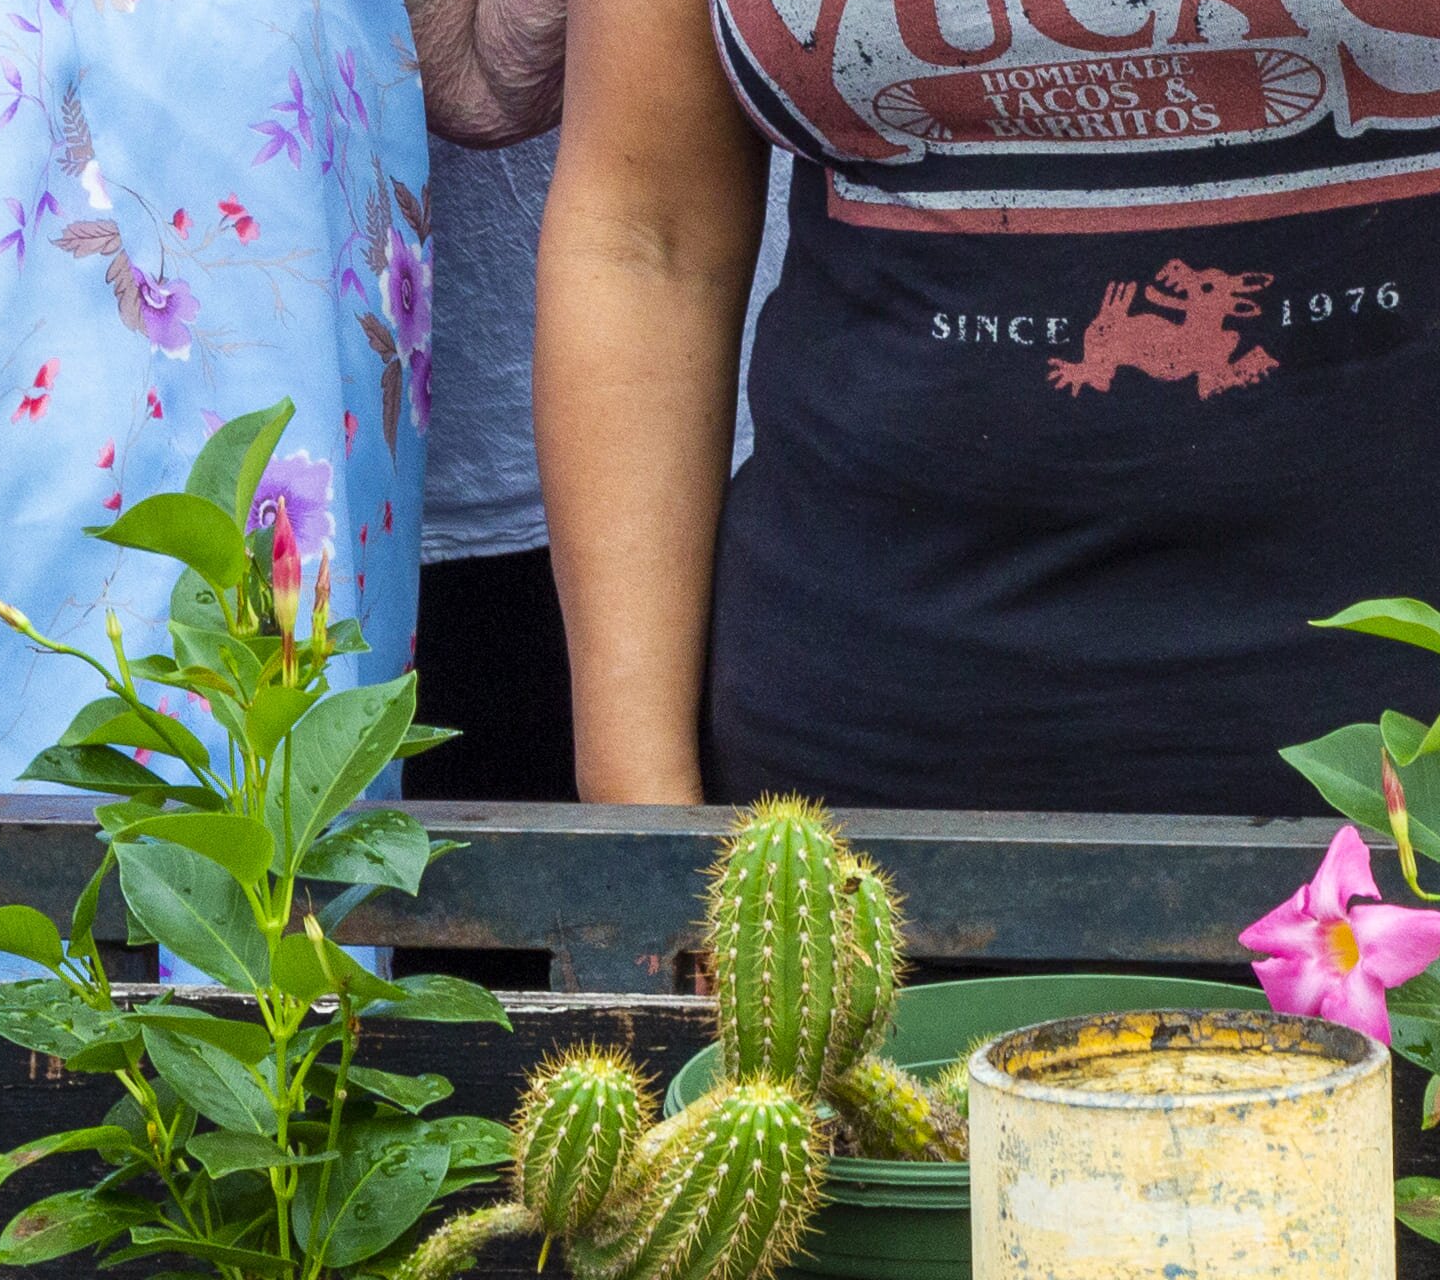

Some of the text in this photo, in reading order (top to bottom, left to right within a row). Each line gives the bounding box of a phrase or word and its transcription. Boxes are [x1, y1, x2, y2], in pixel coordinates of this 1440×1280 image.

[980, 54, 1194, 93] HOMEMADE
[982, 74, 1199, 117] TACOS &
[984, 102, 1222, 138] BURRITOS
[930, 281, 1401, 347] SINCE 1976
